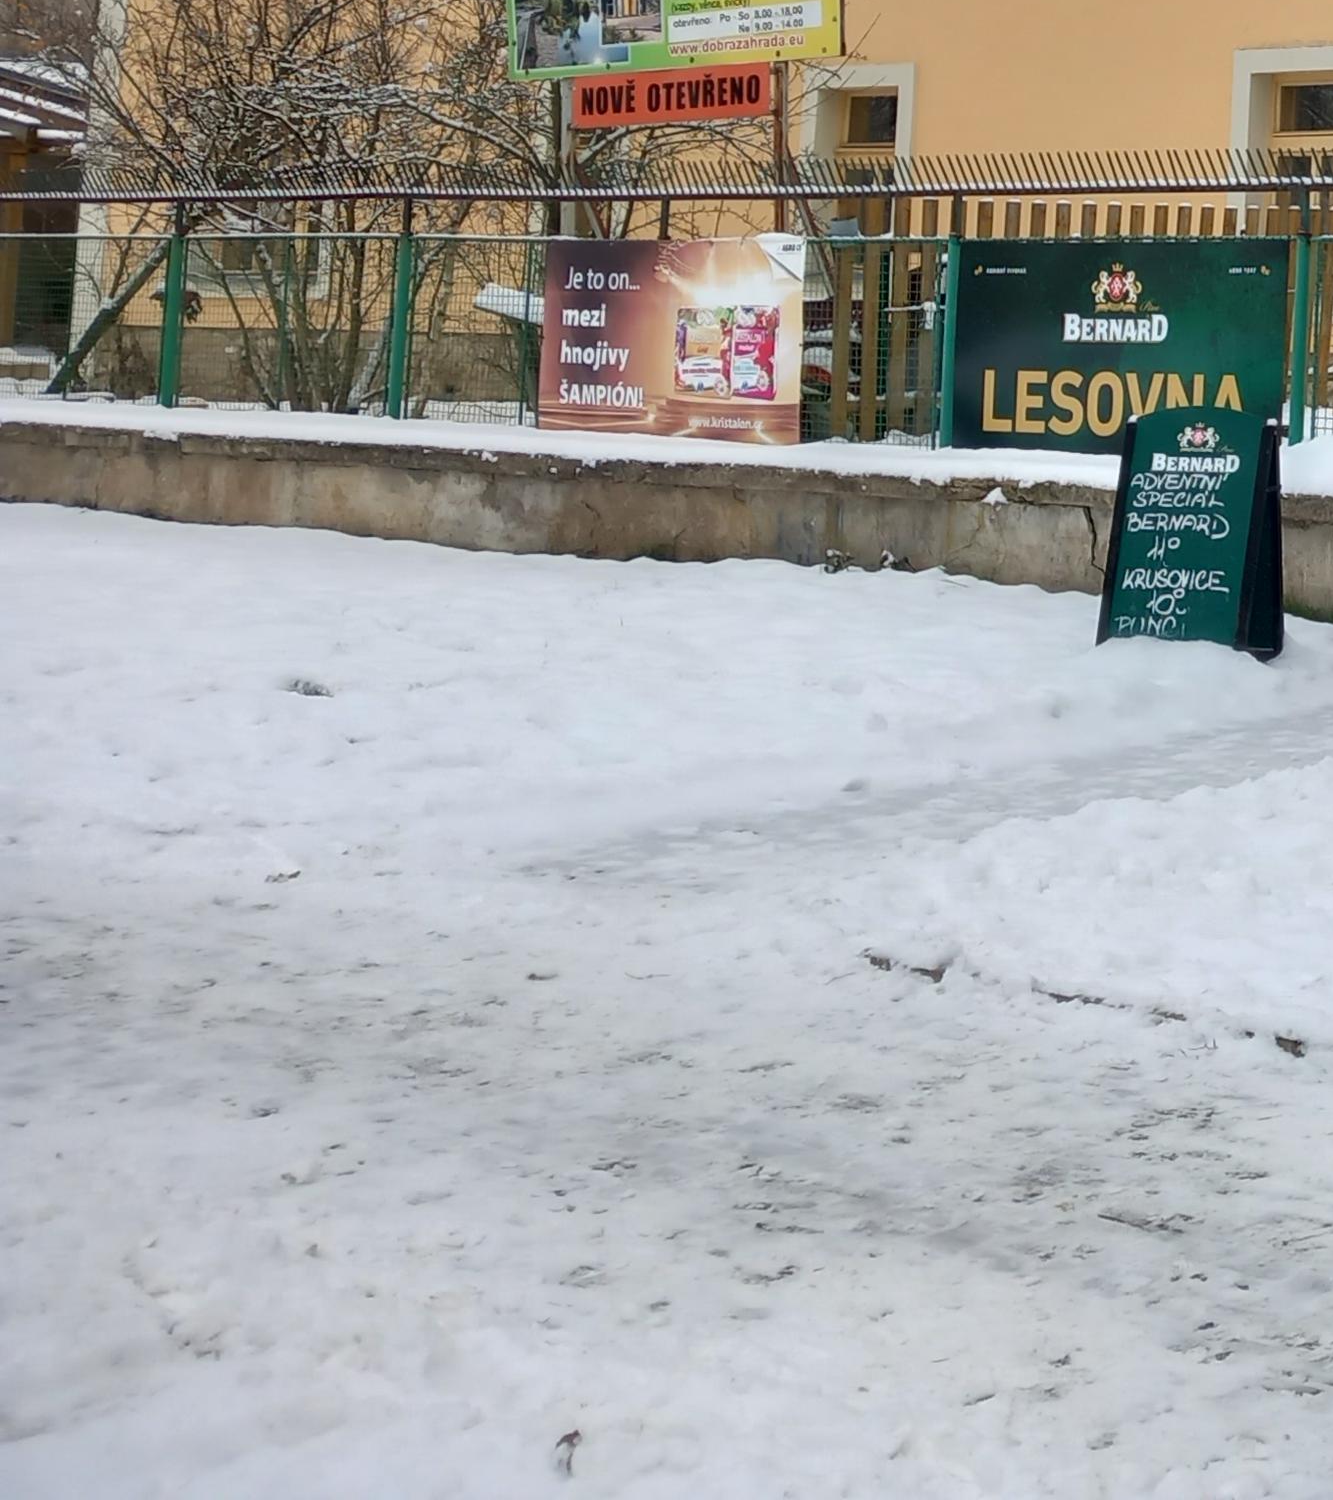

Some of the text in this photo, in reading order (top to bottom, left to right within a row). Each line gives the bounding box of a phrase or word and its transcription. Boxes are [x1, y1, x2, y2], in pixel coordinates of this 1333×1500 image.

[720, 13, 731, 23] Po
[738, 11, 750, 21] So
[738, 24, 751, 33] Ne
[670, 34, 805, 55] www.dobrazahrada.eu
[580, 73, 761, 116] NOVĚ OTEVŘENO
[564, 266, 641, 291] Je to on...
[562, 304, 605, 328] mezi
[1063, 313, 1169, 342] BERNARD
[560, 339, 630, 372] hnojivy
[559, 378, 644, 408] ŠAMPIÓN!
[982, 368, 1244, 438] LESOVNA
[1152, 452, 1240, 474] BERNARD
[1130, 472, 1230, 491] ADVENTNÍ
[1132, 490, 1225, 508] SPECIÁL
[1126, 512, 1230, 539] BERNARD
